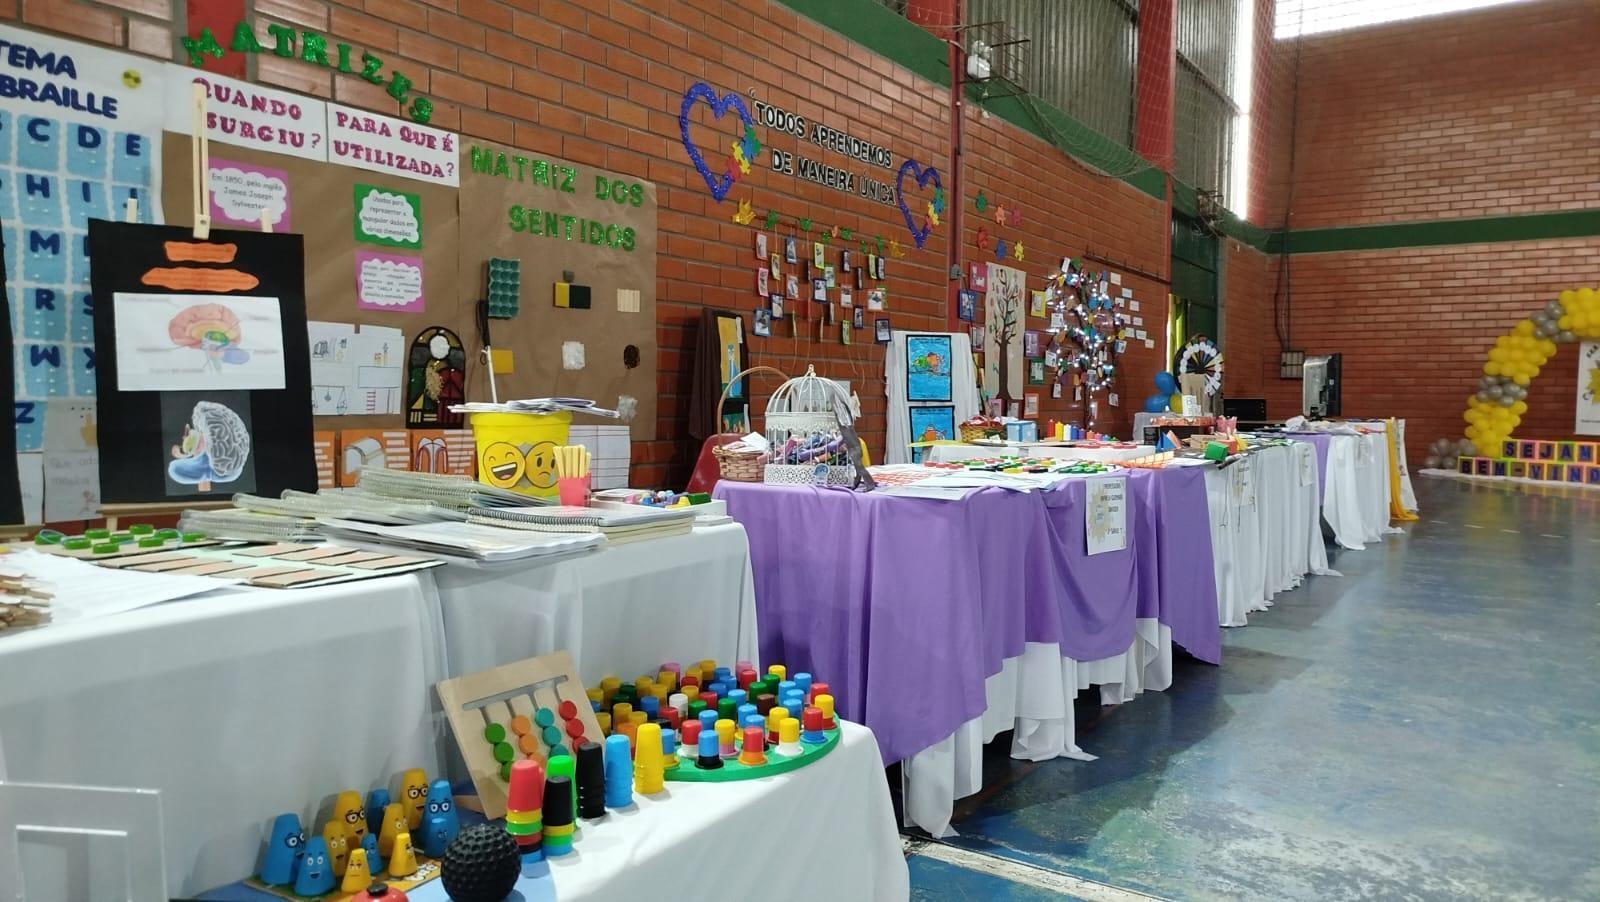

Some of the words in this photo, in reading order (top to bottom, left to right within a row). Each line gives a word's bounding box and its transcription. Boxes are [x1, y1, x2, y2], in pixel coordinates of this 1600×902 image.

[181, 20, 434, 124] MATRIZES
[0, 74, 118, 119] BRAILLE
[27, 118, 50, 142] C
[78, 125, 101, 148] D
[126, 133, 141, 156] E
[335, 111, 392, 138] PARA
[399, 126, 437, 151] QUE
[442, 134, 454, 152] É
[755, 102, 806, 138] TODOS
[811, 123, 893, 168] APRENDEMOS
[26, 173, 50, 198] H
[224, 186, 247, 196] James
[470, 145, 577, 194] MATRIZ
[594, 175, 644, 208] DOS
[772, 149, 793, 175] DE
[797, 157, 854, 192] MANEIRA
[30, 230, 60, 255] M
[508, 204, 637, 251] SENTIDOS
[36, 288, 56, 311] R
[30, 344, 61, 368] W
